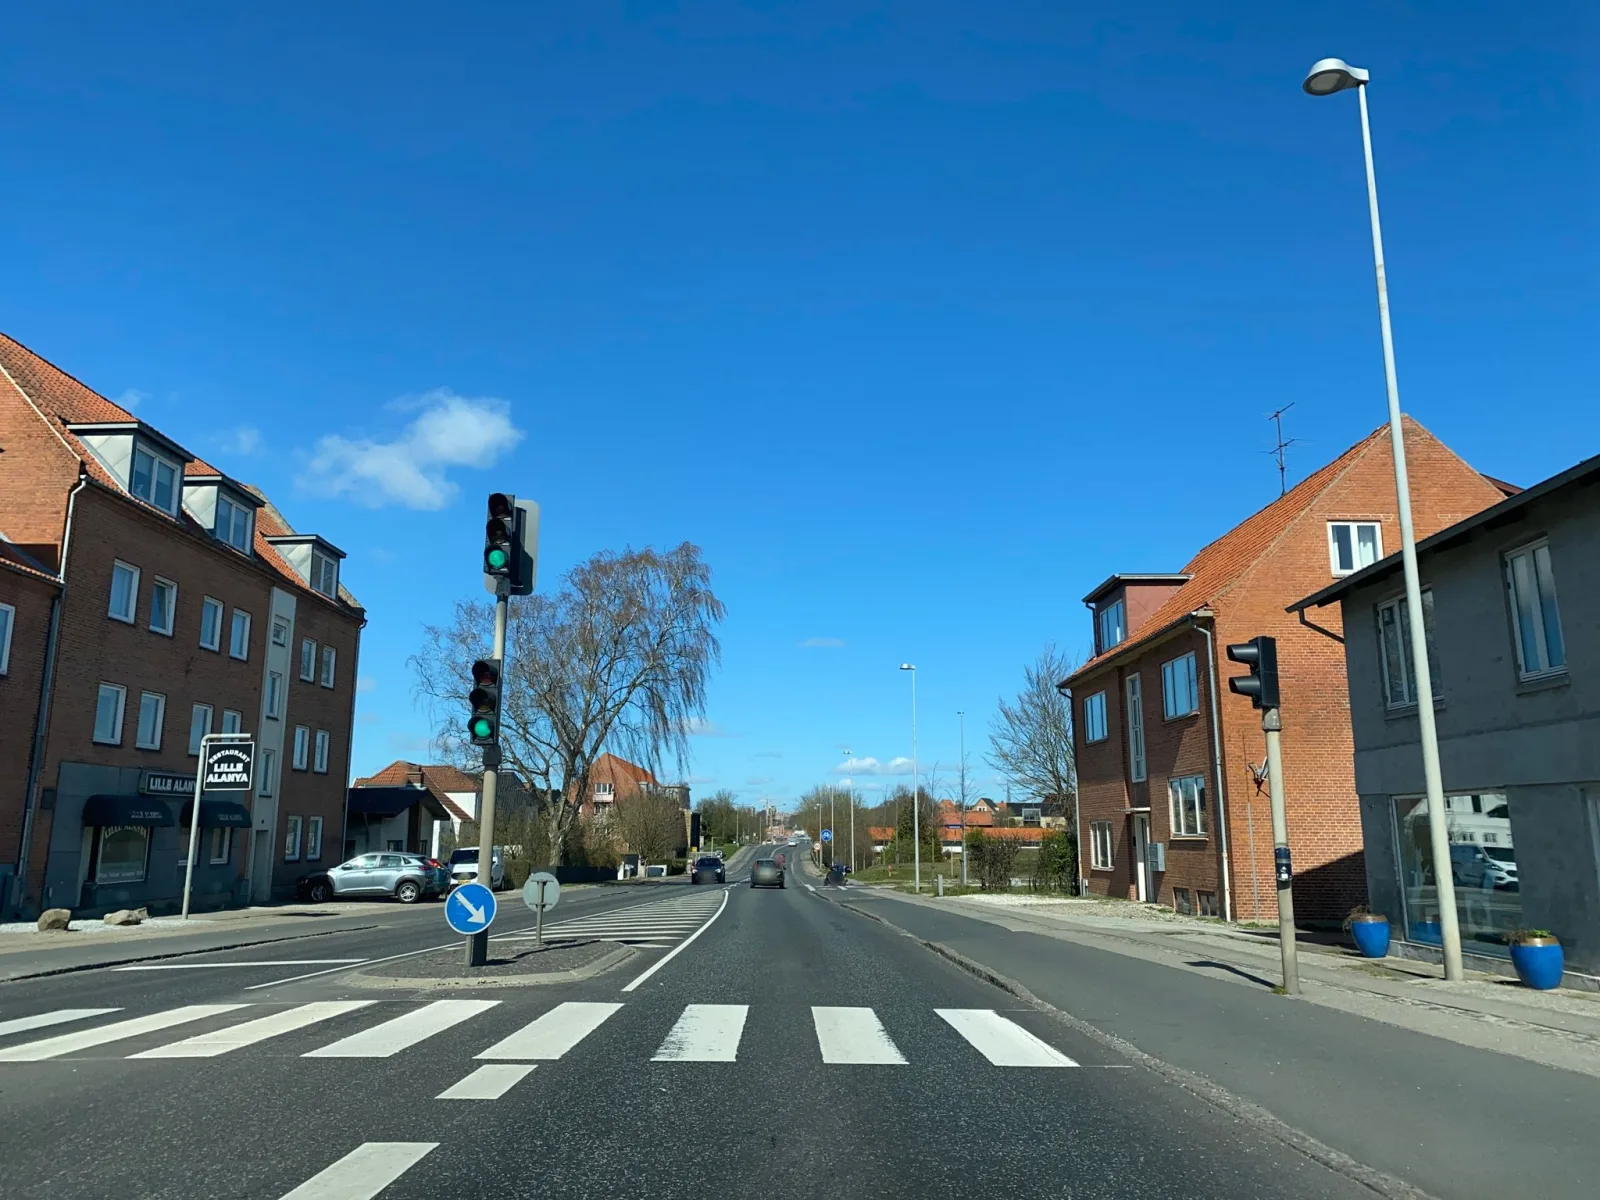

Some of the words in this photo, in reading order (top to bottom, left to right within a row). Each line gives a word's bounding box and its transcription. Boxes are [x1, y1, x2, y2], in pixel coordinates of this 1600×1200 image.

[208, 749, 251, 765] RESTAURANT
[213, 763, 244, 773] LILLE
[205, 772, 249, 783] ALANYA
[149, 777, 172, 791] LILLE
[173, 779, 198, 793] ALANY
